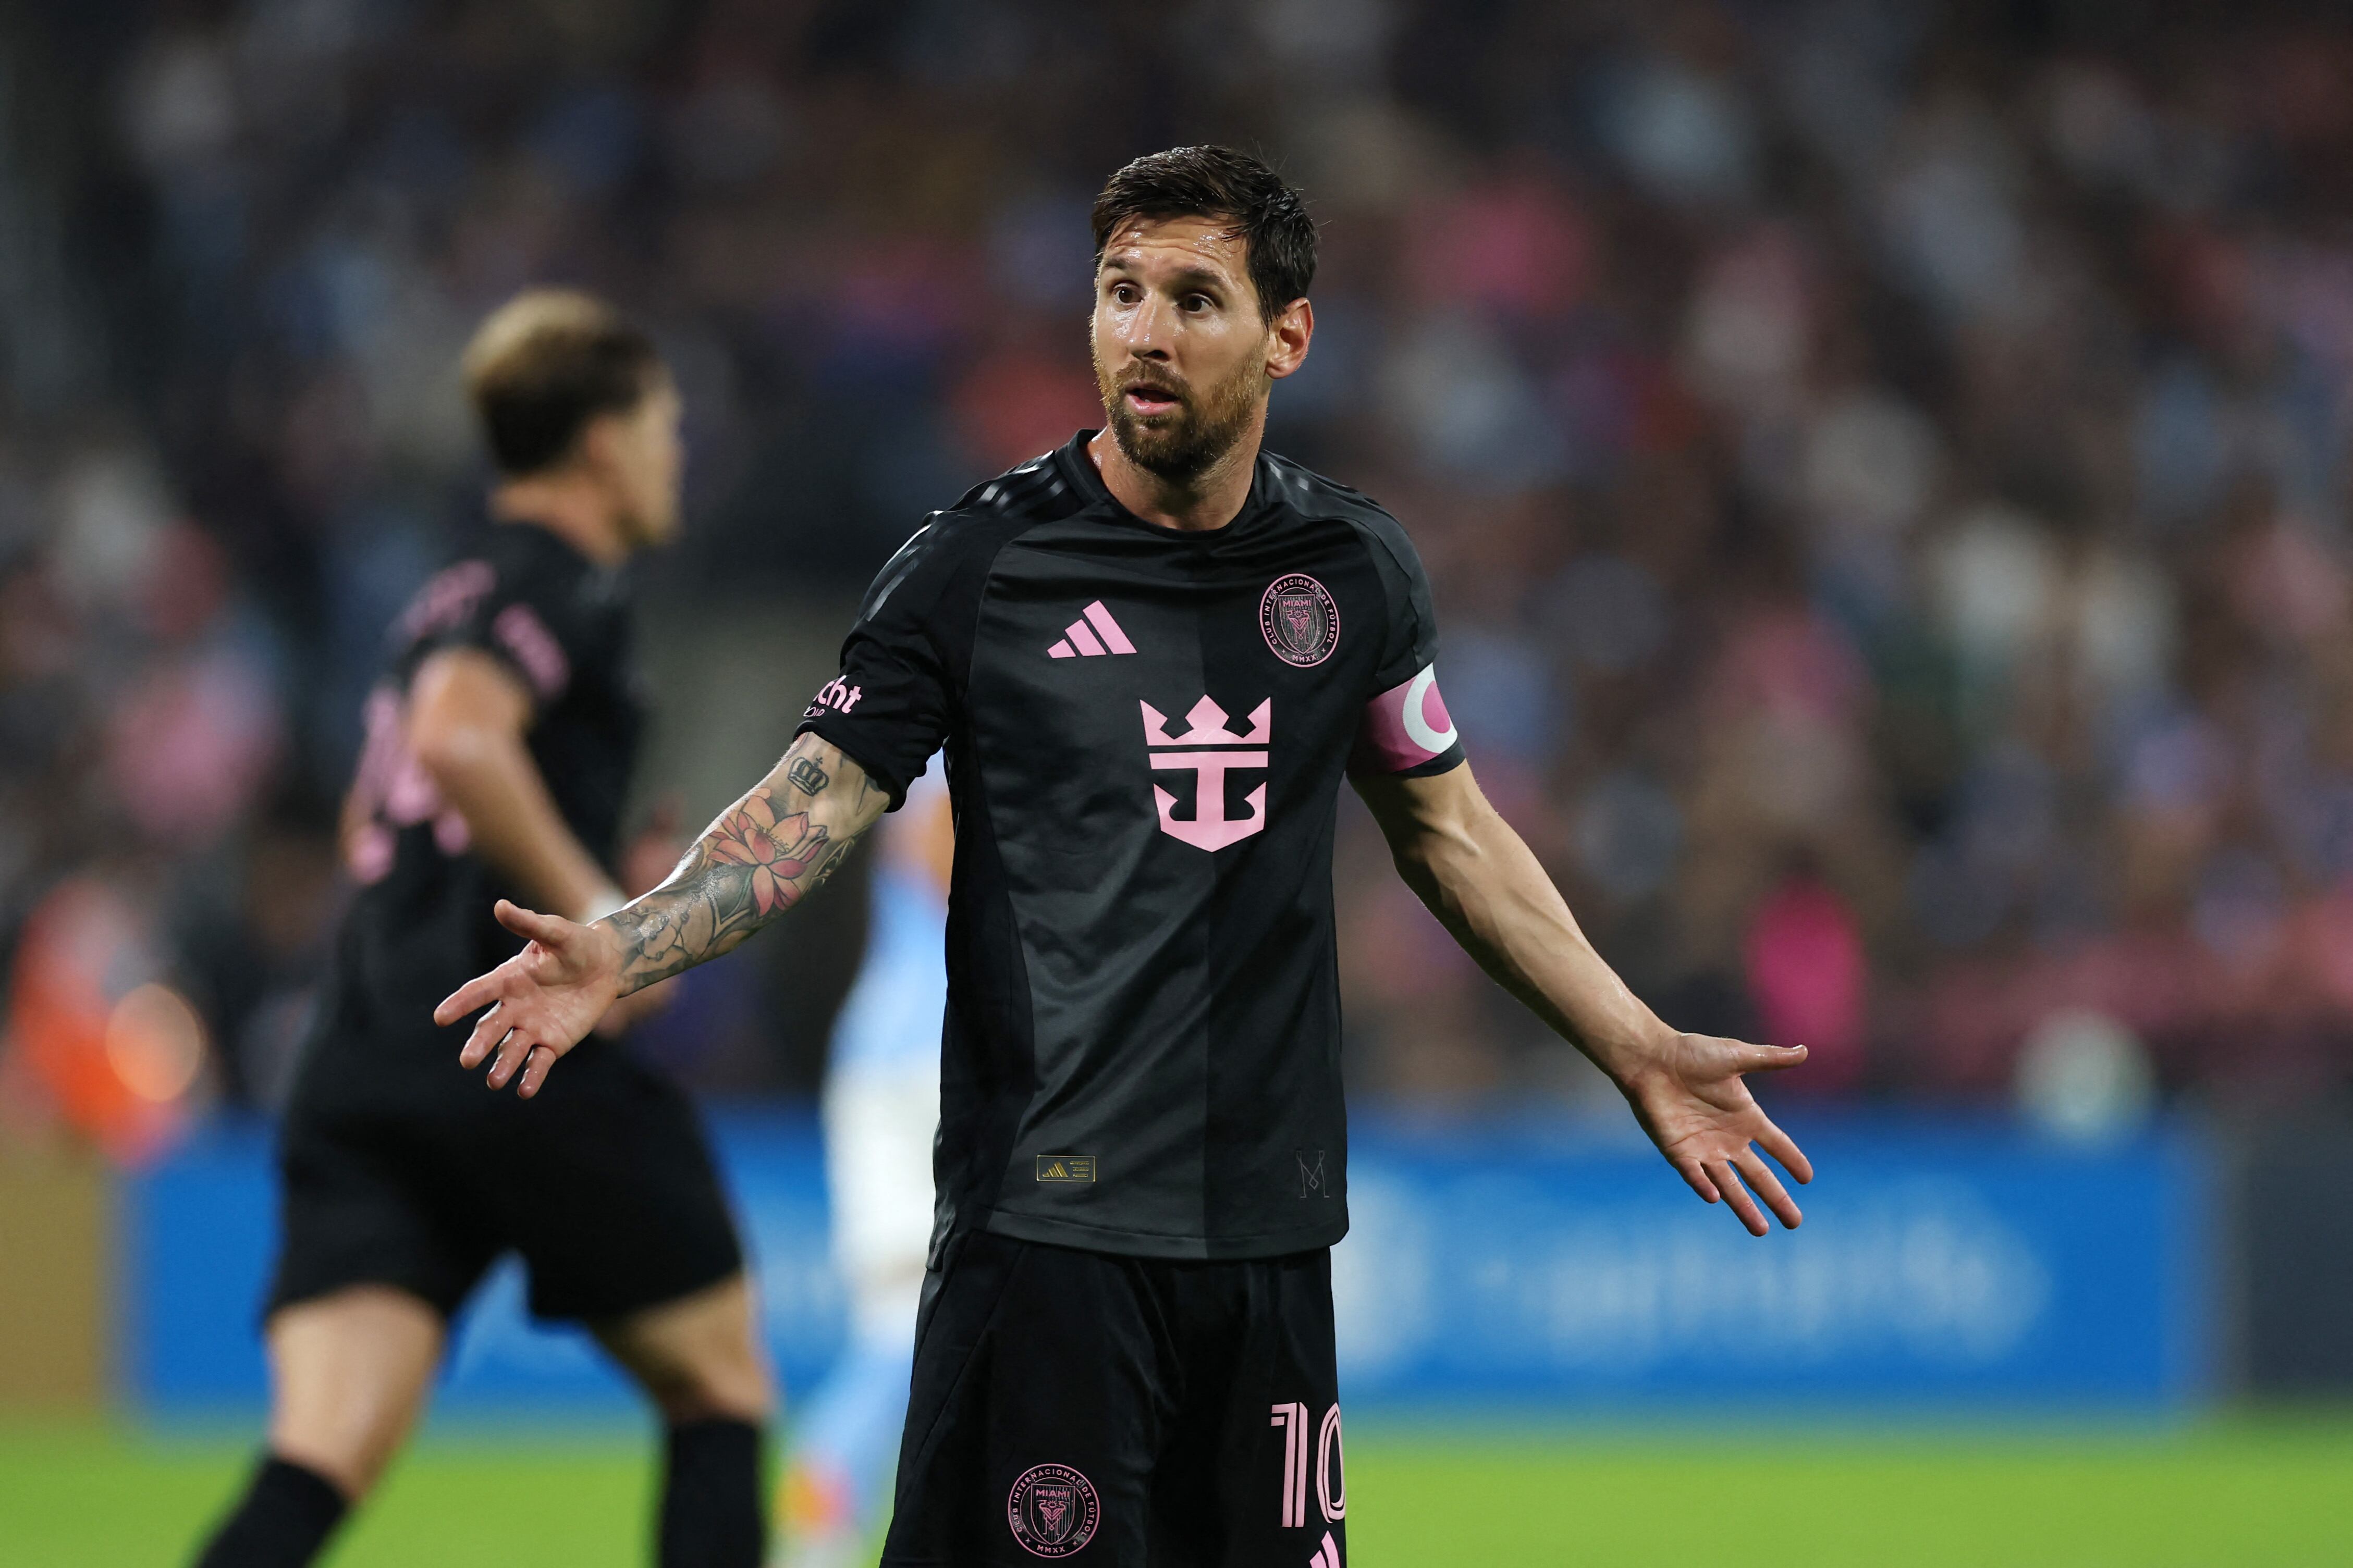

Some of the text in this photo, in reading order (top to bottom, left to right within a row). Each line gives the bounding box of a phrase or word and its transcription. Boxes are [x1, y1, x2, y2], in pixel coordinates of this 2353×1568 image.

[1264, 579, 1320, 616] INTERNACIONAL
[1321, 594, 1330, 606] DE
[1265, 621, 1278, 645] CLUB
[813, 675, 862, 713] cht
[1270, 1402, 1346, 1527] 10
[1013, 1468, 1081, 1503] INTERNACIONAL
[1036, 1489, 1071, 1498] MIAMI
[1081, 1486, 1092, 1499] DE
[1012, 1508, 1023, 1532] CLUB
[1036, 1544, 1065, 1553] MMXX
